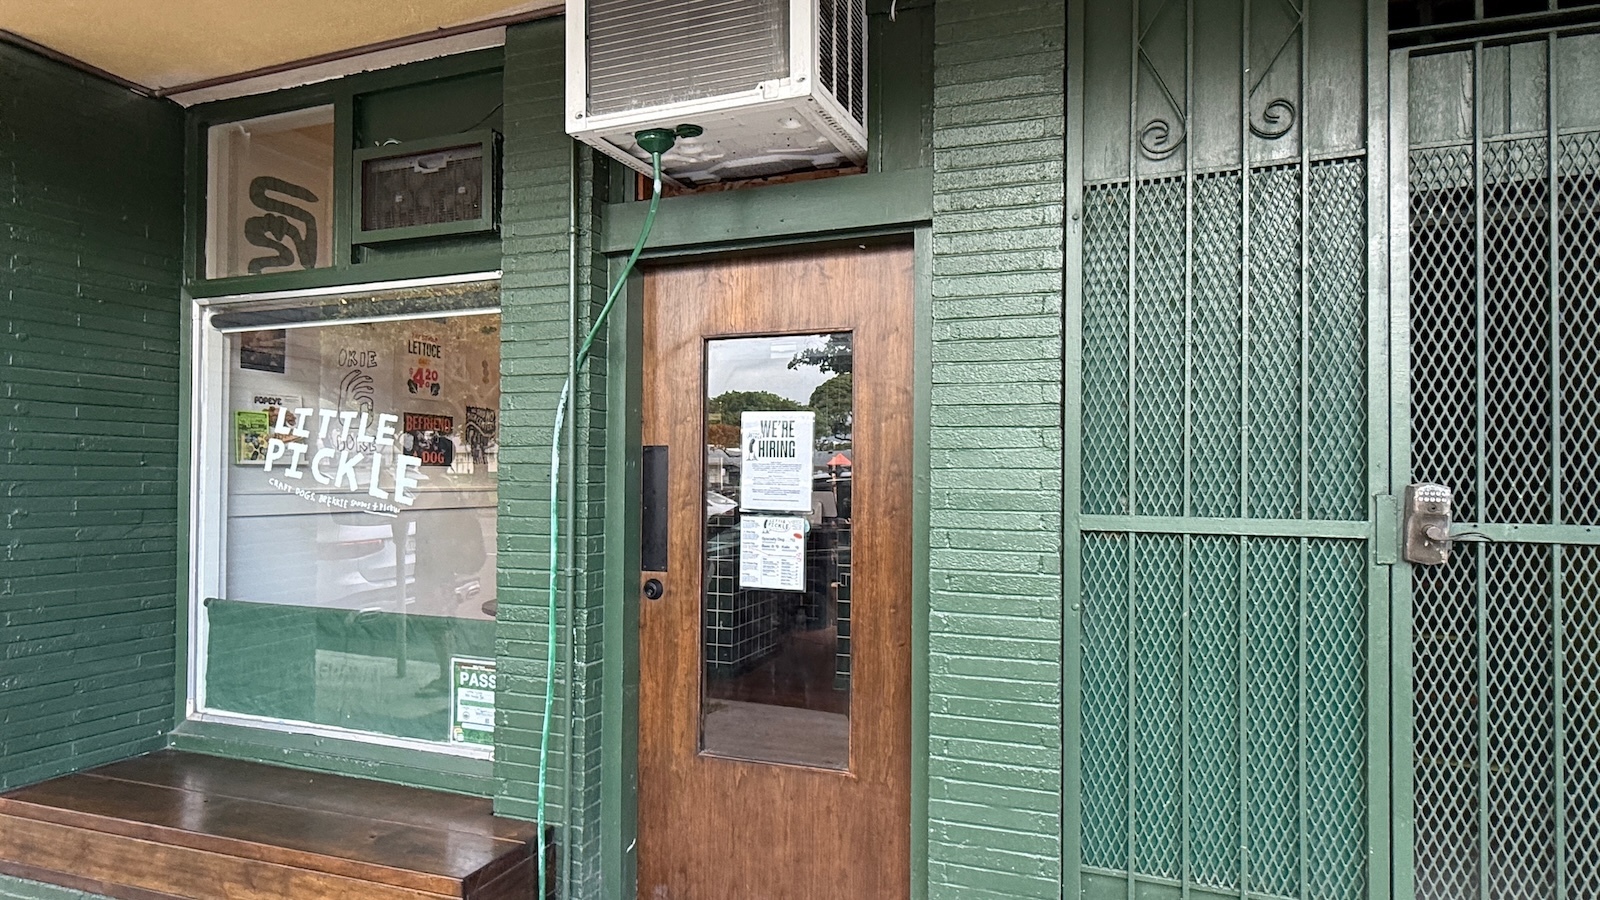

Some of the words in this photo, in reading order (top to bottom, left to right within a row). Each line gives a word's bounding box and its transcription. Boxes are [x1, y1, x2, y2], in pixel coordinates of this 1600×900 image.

[338, 348, 378, 368] OKIE
[408, 339, 442, 359] LETTUCE
[274, 407, 399, 446] LITTLE
[406, 415, 450, 432] BEFRIEND
[760, 420, 796, 438] WE'RE
[422, 451, 445, 464] DOG
[758, 440, 796, 458] HIRING
[264, 438, 422, 506] PICKLE
[268, 478, 293, 493] CRAFT
[460, 671, 496, 689] PASS
